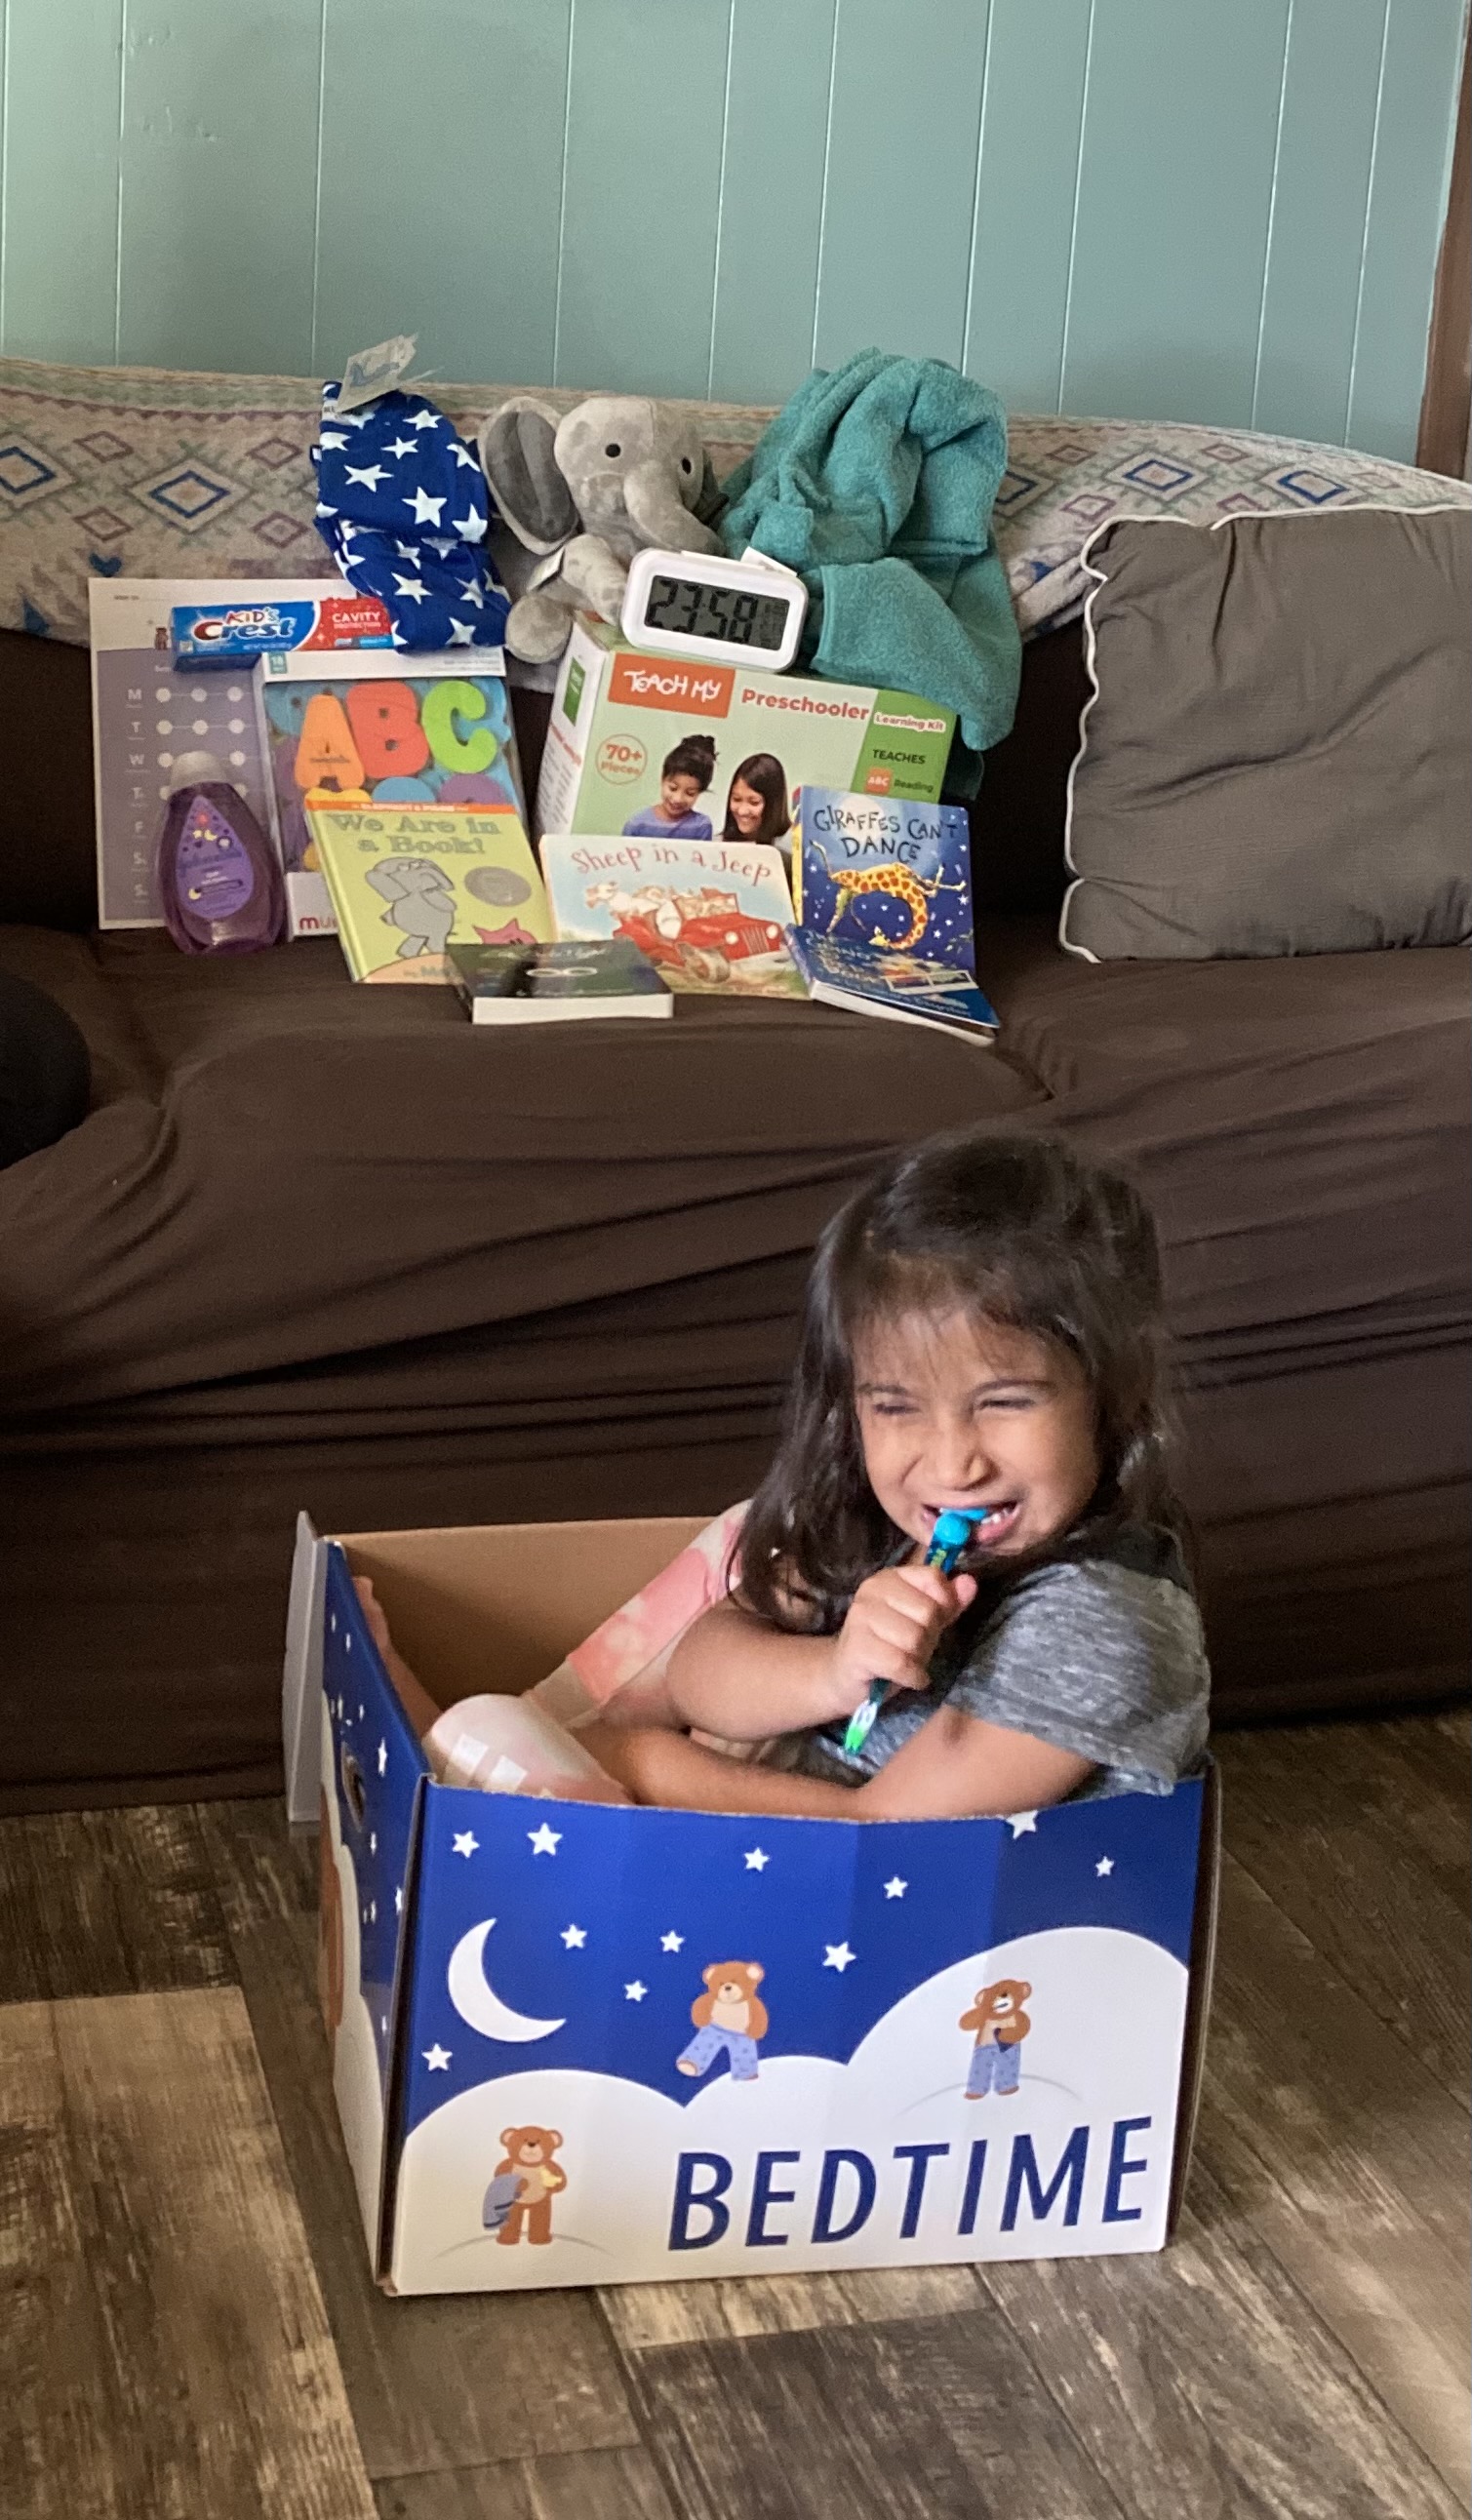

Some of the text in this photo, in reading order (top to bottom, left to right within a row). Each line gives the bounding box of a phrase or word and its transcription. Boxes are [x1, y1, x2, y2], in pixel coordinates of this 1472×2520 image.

[332, 611, 380, 623] CAVITY
[193, 617, 297, 641] Crest
[741, 689, 869, 720] Preschooler
[876, 713, 925, 729] Learning
[607, 744, 642, 762] 70+
[872, 749, 926, 765] TEACHES
[868, 776, 890, 787] ABC
[895, 778, 934, 794] Reading
[327, 813, 384, 832] We
[396, 815, 456, 833] Are
[814, 806, 958, 840] GIRAFFES CAN'T
[358, 835, 485, 853] a Book!
[840, 836, 921, 863] DANCE
[571, 844, 771, 886] Sheep in a Jeep
[668, 2116, 1152, 2250] BEDTIME
